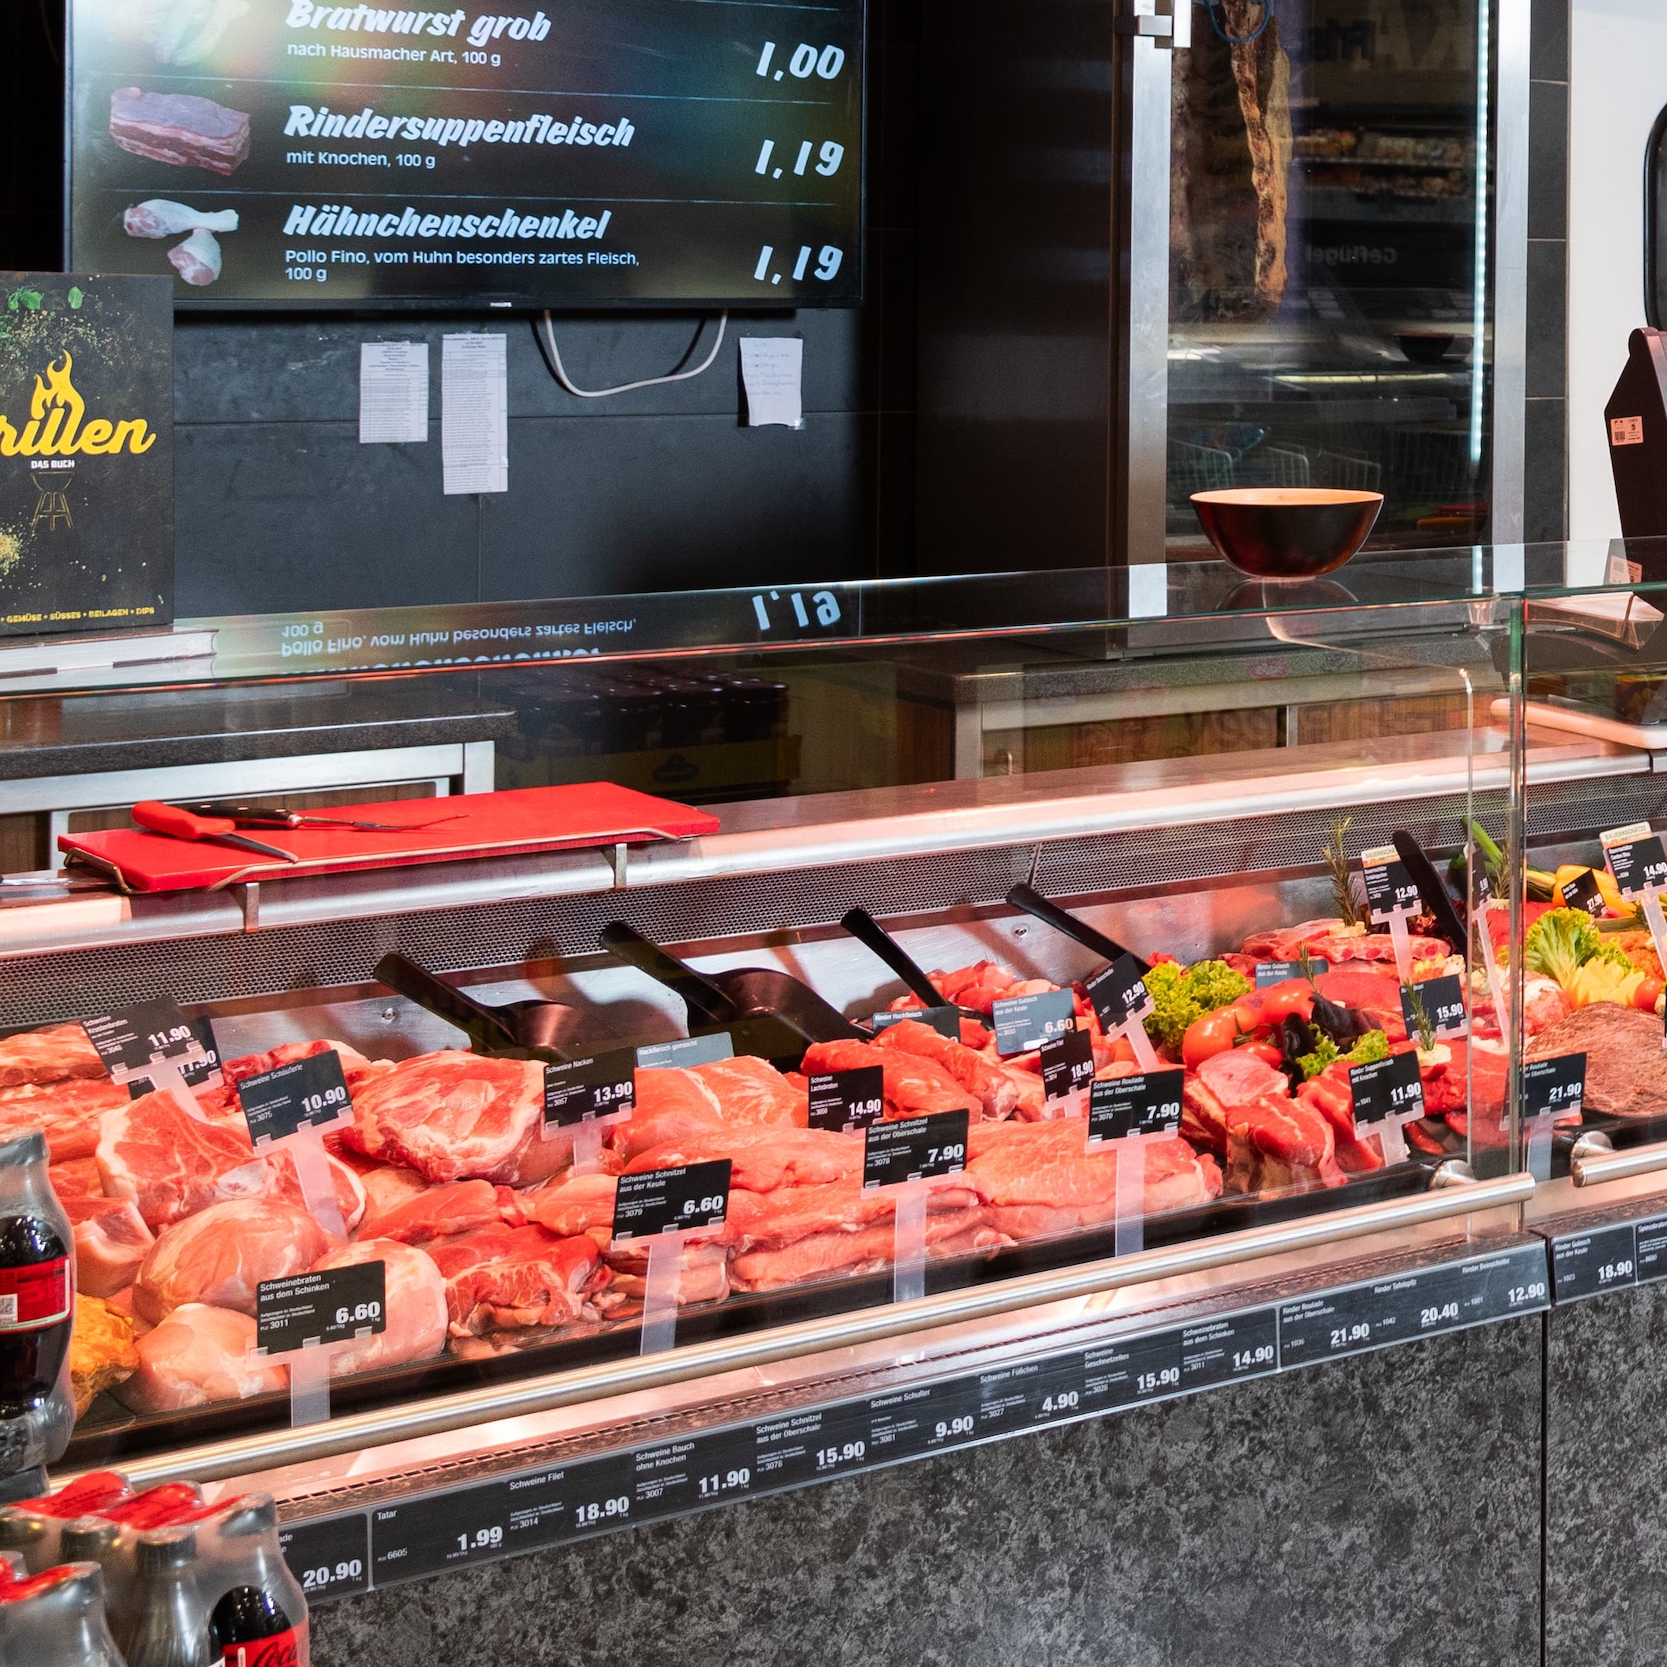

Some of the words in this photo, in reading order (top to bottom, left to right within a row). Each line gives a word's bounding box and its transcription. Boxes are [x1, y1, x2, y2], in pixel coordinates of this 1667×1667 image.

[467, 10, 551, 48] grob
[288, 43, 326, 57] nach
[331, 45, 426, 62] Hausmacher
[430, 51, 458, 65] Art,
[462, 52, 488, 65] 100
[491, 54, 501, 67] g
[756, 41, 845, 81] 1,00
[284, 105, 635, 147] Rindersuppenfleisch
[286, 151, 315, 165] mit
[318, 152, 391, 168] Knochen,
[395, 154, 421, 167] 100
[425, 156, 436, 169] g
[755, 140, 844, 179] 1,19
[283, 204, 612, 239] Hähnchenschenkel
[285, 250, 327, 263] Pollo
[331, 250, 370, 265] Fino,
[374, 252, 408, 264] vom
[413, 251, 452, 264] Huhn
[457, 252, 535, 265] besonders
[539, 252, 583, 265] zartes
[587, 252, 640, 266] Fleisch,
[754, 245, 843, 284] 1,19
[285, 268, 312, 280] 100
[316, 269, 327, 282] g
[0, 408, 156, 457] rillen
[31, 460, 49, 469] DAS
[51, 459, 75, 468] BUCH
[7, 612, 42, 623] GEMÜSE
[50, 611, 81, 621] SÜSSES
[89, 608, 128, 618] BEILAGEN
[136, 606, 155, 615] DIPS
[148, 1025, 192, 1047] 11.90
[1044, 1018, 1074, 1034] 6.60
[546, 1062, 573, 1075] Schweine
[575, 1057, 594, 1068] Nacken
[240, 1075, 270, 1090] Schweine
[593, 1081, 633, 1104] 13.90
[1093, 1080, 1121, 1090] Schweine
[1122, 1076, 1144, 1086] Roulade
[301, 1086, 347, 1113] 10.90
[849, 1098, 882, 1117] 14.90
[1147, 1102, 1180, 1120] 7.90
[868, 1124, 898, 1134] Schweine
[899, 1117, 928, 1129] Schnitzel
[868, 1135, 880, 1143] aus
[881, 1133, 893, 1141] der
[894, 1126, 927, 1139] Oberschale
[928, 1144, 964, 1164] 7.90
[619, 1184, 632, 1192] aus
[633, 1182, 646, 1191] der
[647, 1180, 666, 1190] Keule
[620, 1171, 654, 1185] Schweine
[655, 1167, 687, 1179] Schnitzel
[683, 1195, 724, 1215] 6.60
[1598, 1259, 1633, 1281] 18.90
[260, 1275, 321, 1292] Schweinebraten
[276, 1291, 293, 1299] dem
[294, 1283, 330, 1295] Schinken
[1508, 1282, 1545, 1303] 12.90
[336, 1301, 380, 1324] 6.60
[1421, 1302, 1459, 1324] 20.40
[270, 1319, 289, 1329] 3011
[1330, 1323, 1370, 1345] 21.90
[1233, 1345, 1274, 1368] 14.90
[1011, 1363, 1038, 1378] Füßchen
[1137, 1367, 1180, 1391] 15.90
[870, 1394, 902, 1409] Schweine
[903, 1388, 931, 1402] Schulter
[1042, 1390, 1079, 1412] 4.90
[756, 1418, 790, 1435] Schweine
[791, 1413, 822, 1427] Schnitzel
[935, 1415, 974, 1438] 9.90
[636, 1446, 671, 1462] Schweine
[672, 1441, 695, 1455] Bauch
[816, 1441, 865, 1466] 15.90
[636, 1461, 654, 1471] ohne
[655, 1454, 687, 1468] Knochen
[510, 1476, 547, 1490] Schweine
[548, 1471, 564, 1483] Filet
[699, 1467, 750, 1494] 11.90
[377, 1509, 397, 1520] Tatar
[575, 1496, 630, 1523] 18.90
[457, 1525, 503, 1552] 1.99
[387, 1548, 408, 1559] 6605
[302, 1559, 362, 1589] 20.90
